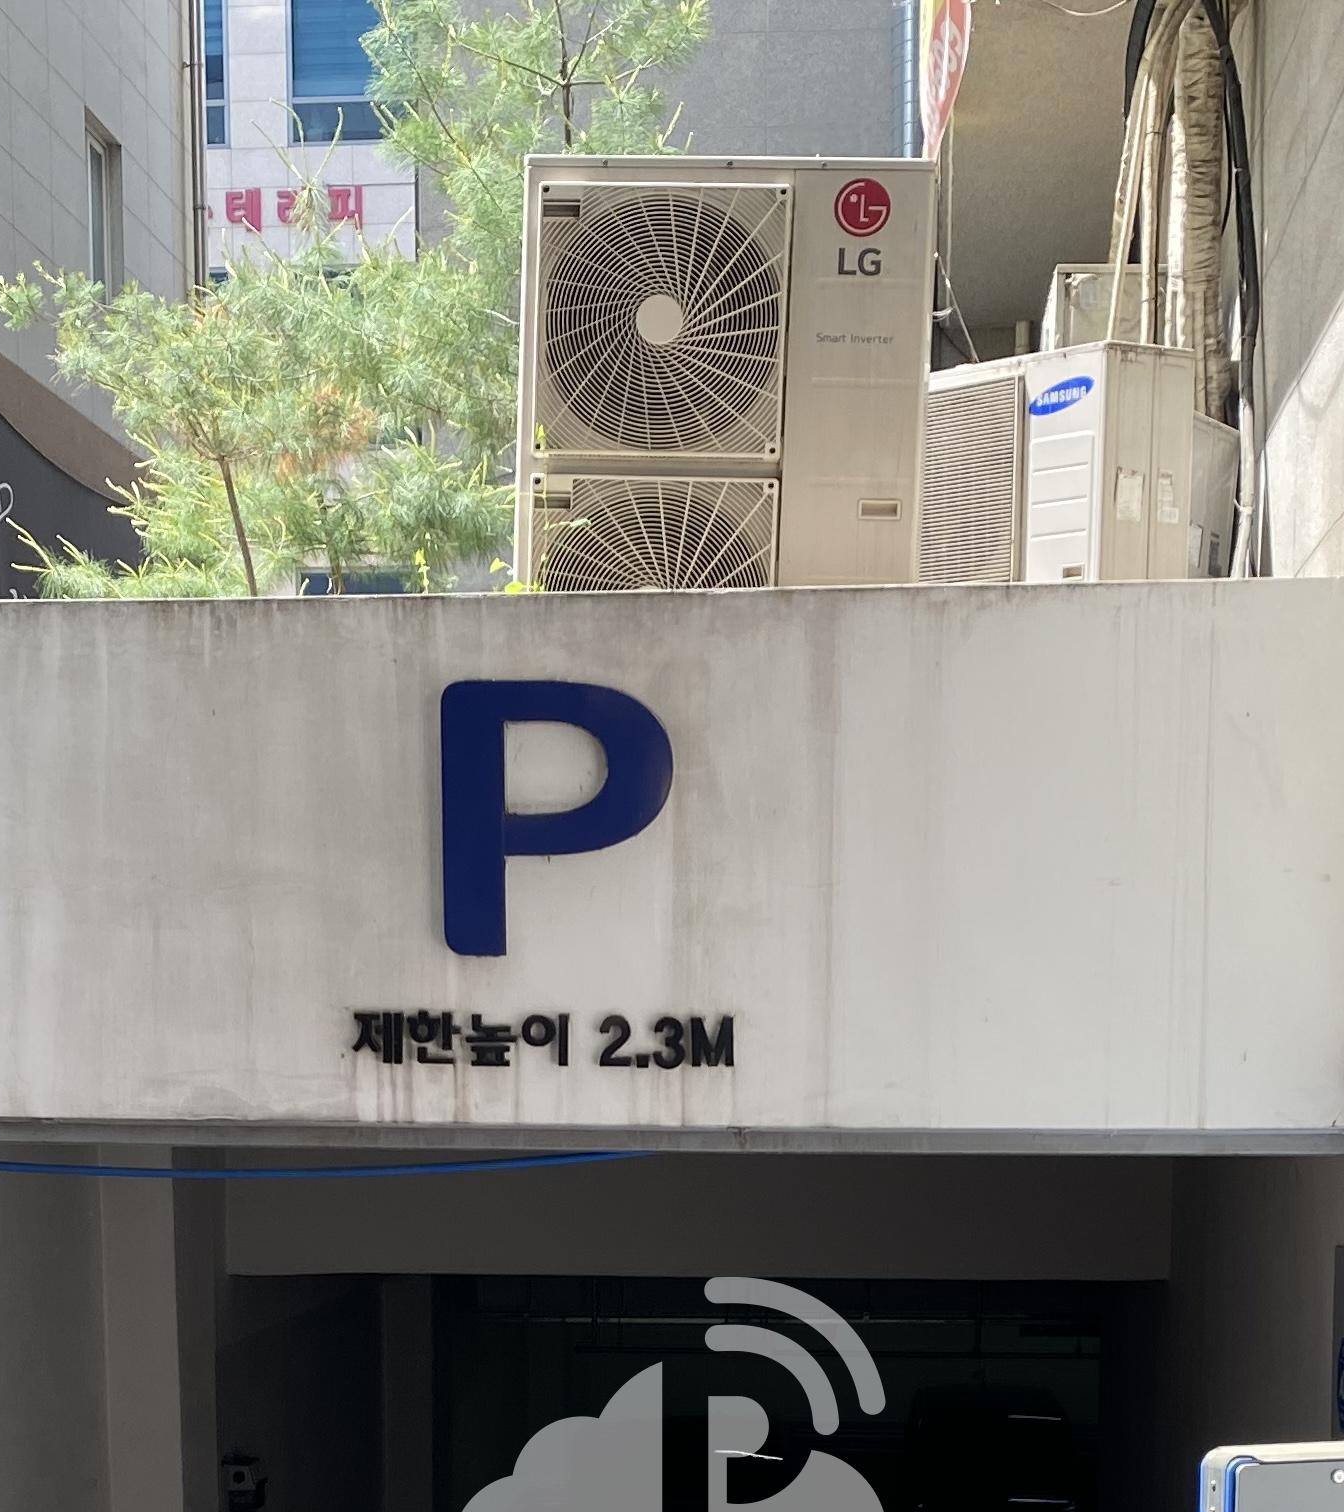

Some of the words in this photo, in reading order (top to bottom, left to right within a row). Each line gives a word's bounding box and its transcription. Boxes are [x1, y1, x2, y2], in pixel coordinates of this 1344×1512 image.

[837, 247, 882, 276] LG
[816, 332, 846, 344] Smart
[850, 332, 894, 345] Inverter
[1036, 385, 1088, 407] SAMSUNG
[441, 680, 673, 956] P
[353, 1010, 569, 1066] 제한높이
[599, 1014, 735, 1070] 2.3M
